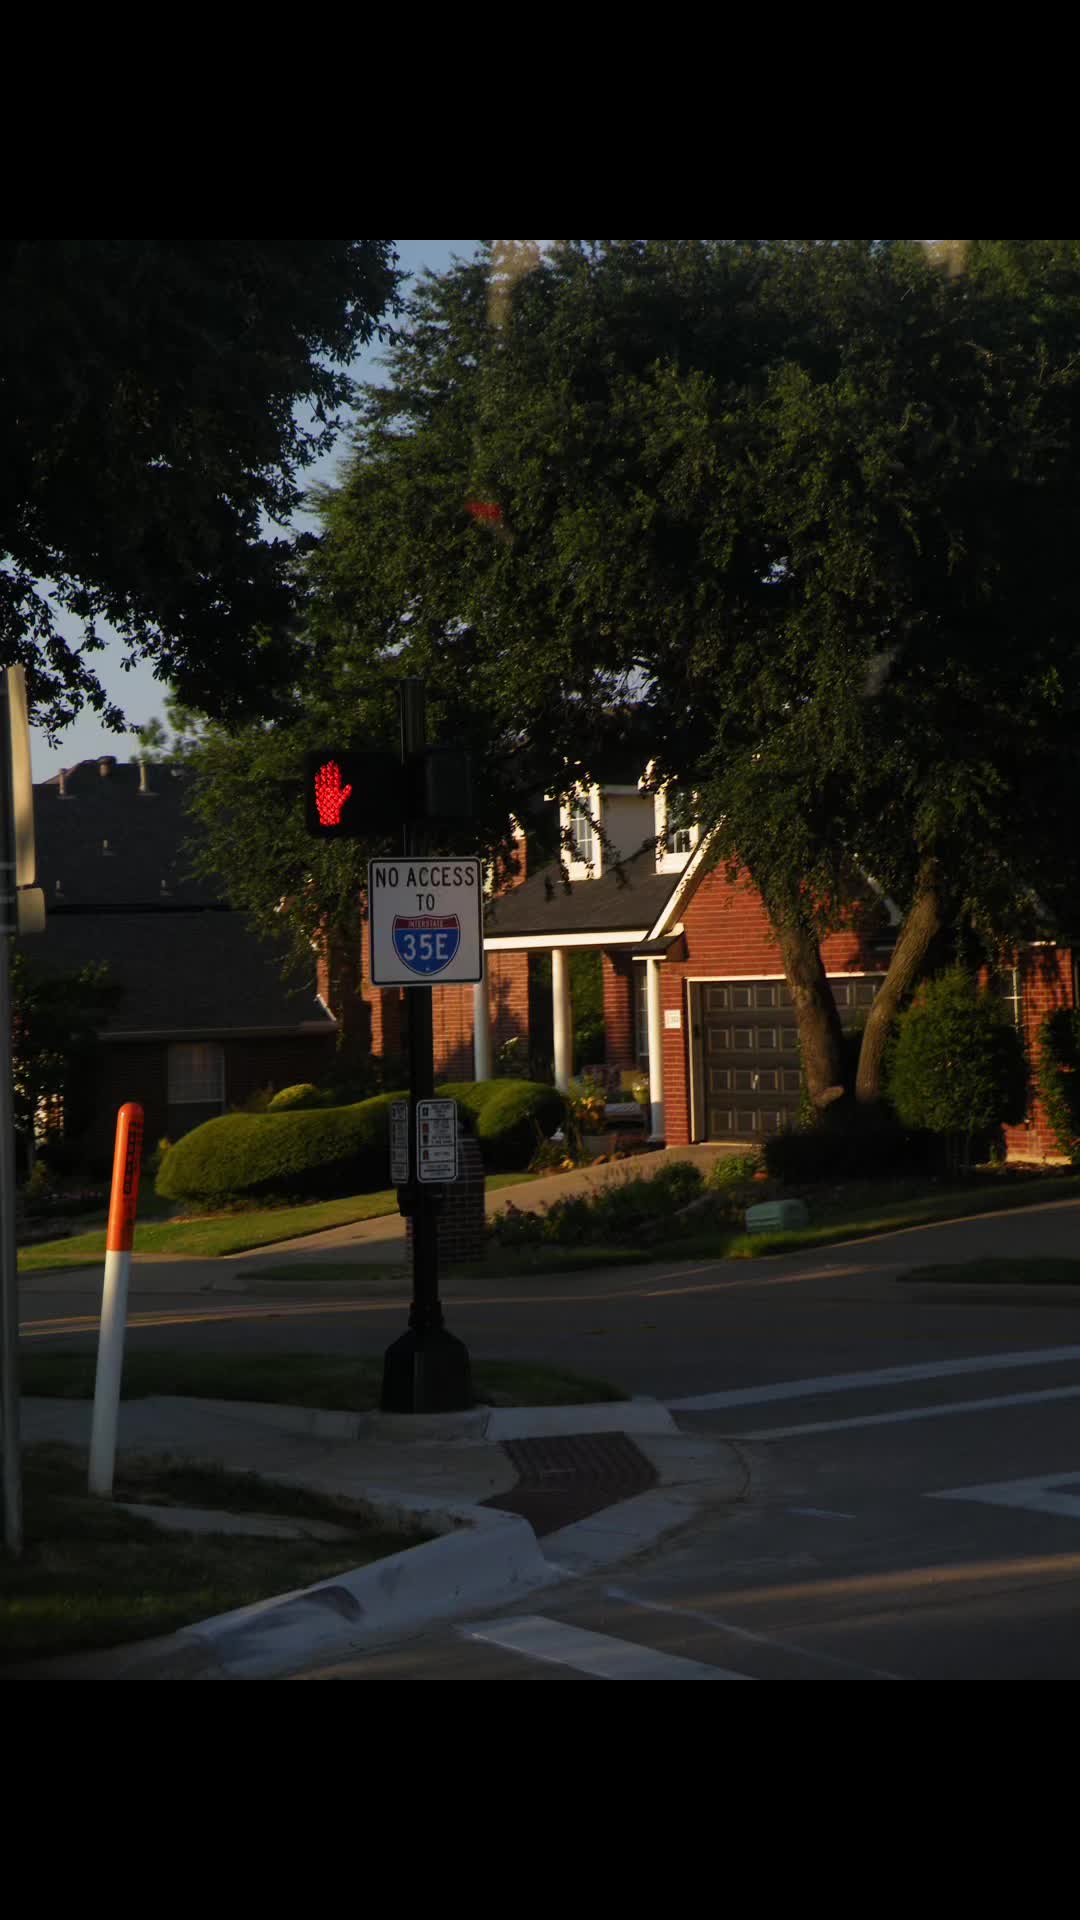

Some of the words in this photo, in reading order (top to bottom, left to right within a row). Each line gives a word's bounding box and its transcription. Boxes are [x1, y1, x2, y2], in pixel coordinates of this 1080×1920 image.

[376, 867, 399, 888] NO
[406, 866, 475, 888] ACCESS
[416, 894, 435, 911] TO
[403, 934, 449, 960] 35E
